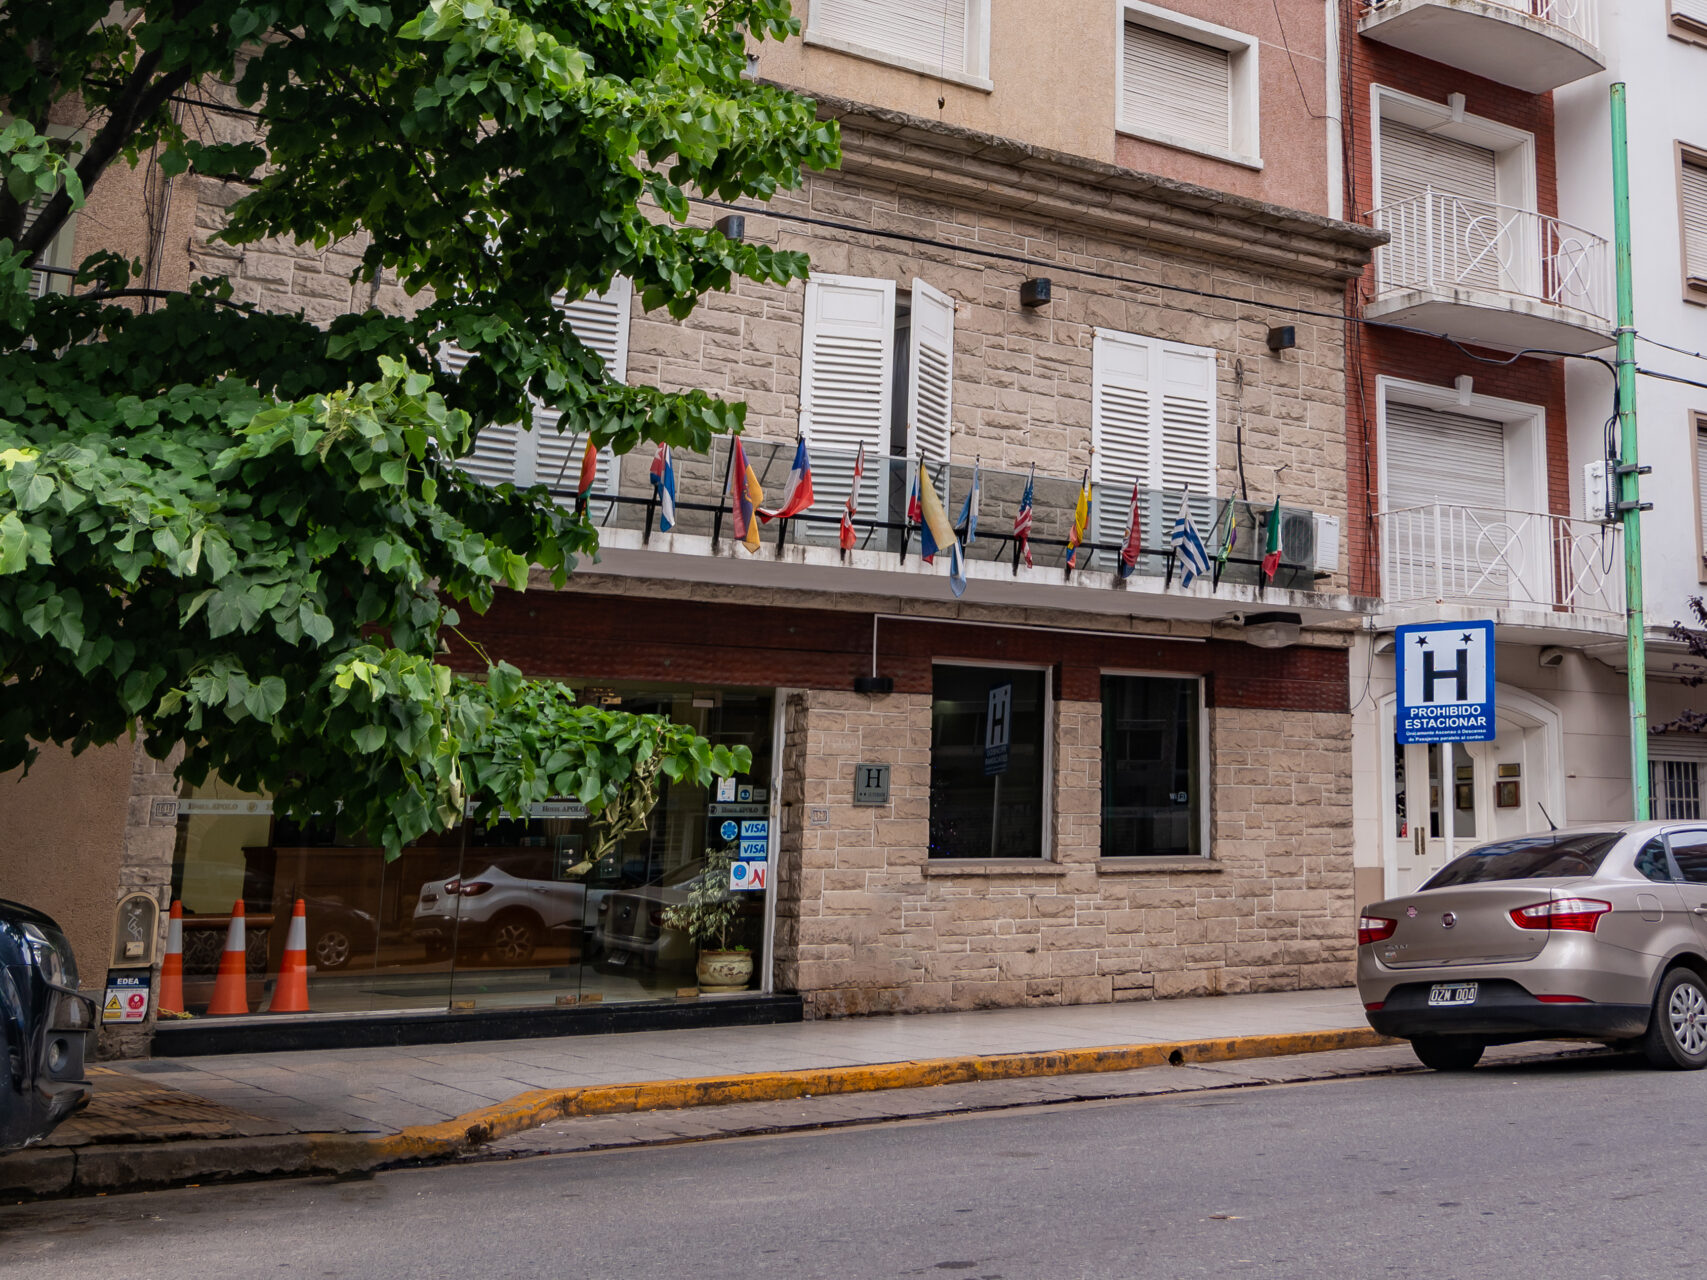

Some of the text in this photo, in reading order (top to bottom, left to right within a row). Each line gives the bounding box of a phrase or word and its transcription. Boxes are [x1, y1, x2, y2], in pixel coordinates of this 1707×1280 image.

[1423, 649, 1468, 703] H
[1410, 705, 1481, 718] PROHIBIDO
[1405, 716, 1486, 729] ESTACIONAR
[865, 768, 882, 788] H
[744, 824, 766, 833] VISA
[743, 844, 765, 854] VISA
